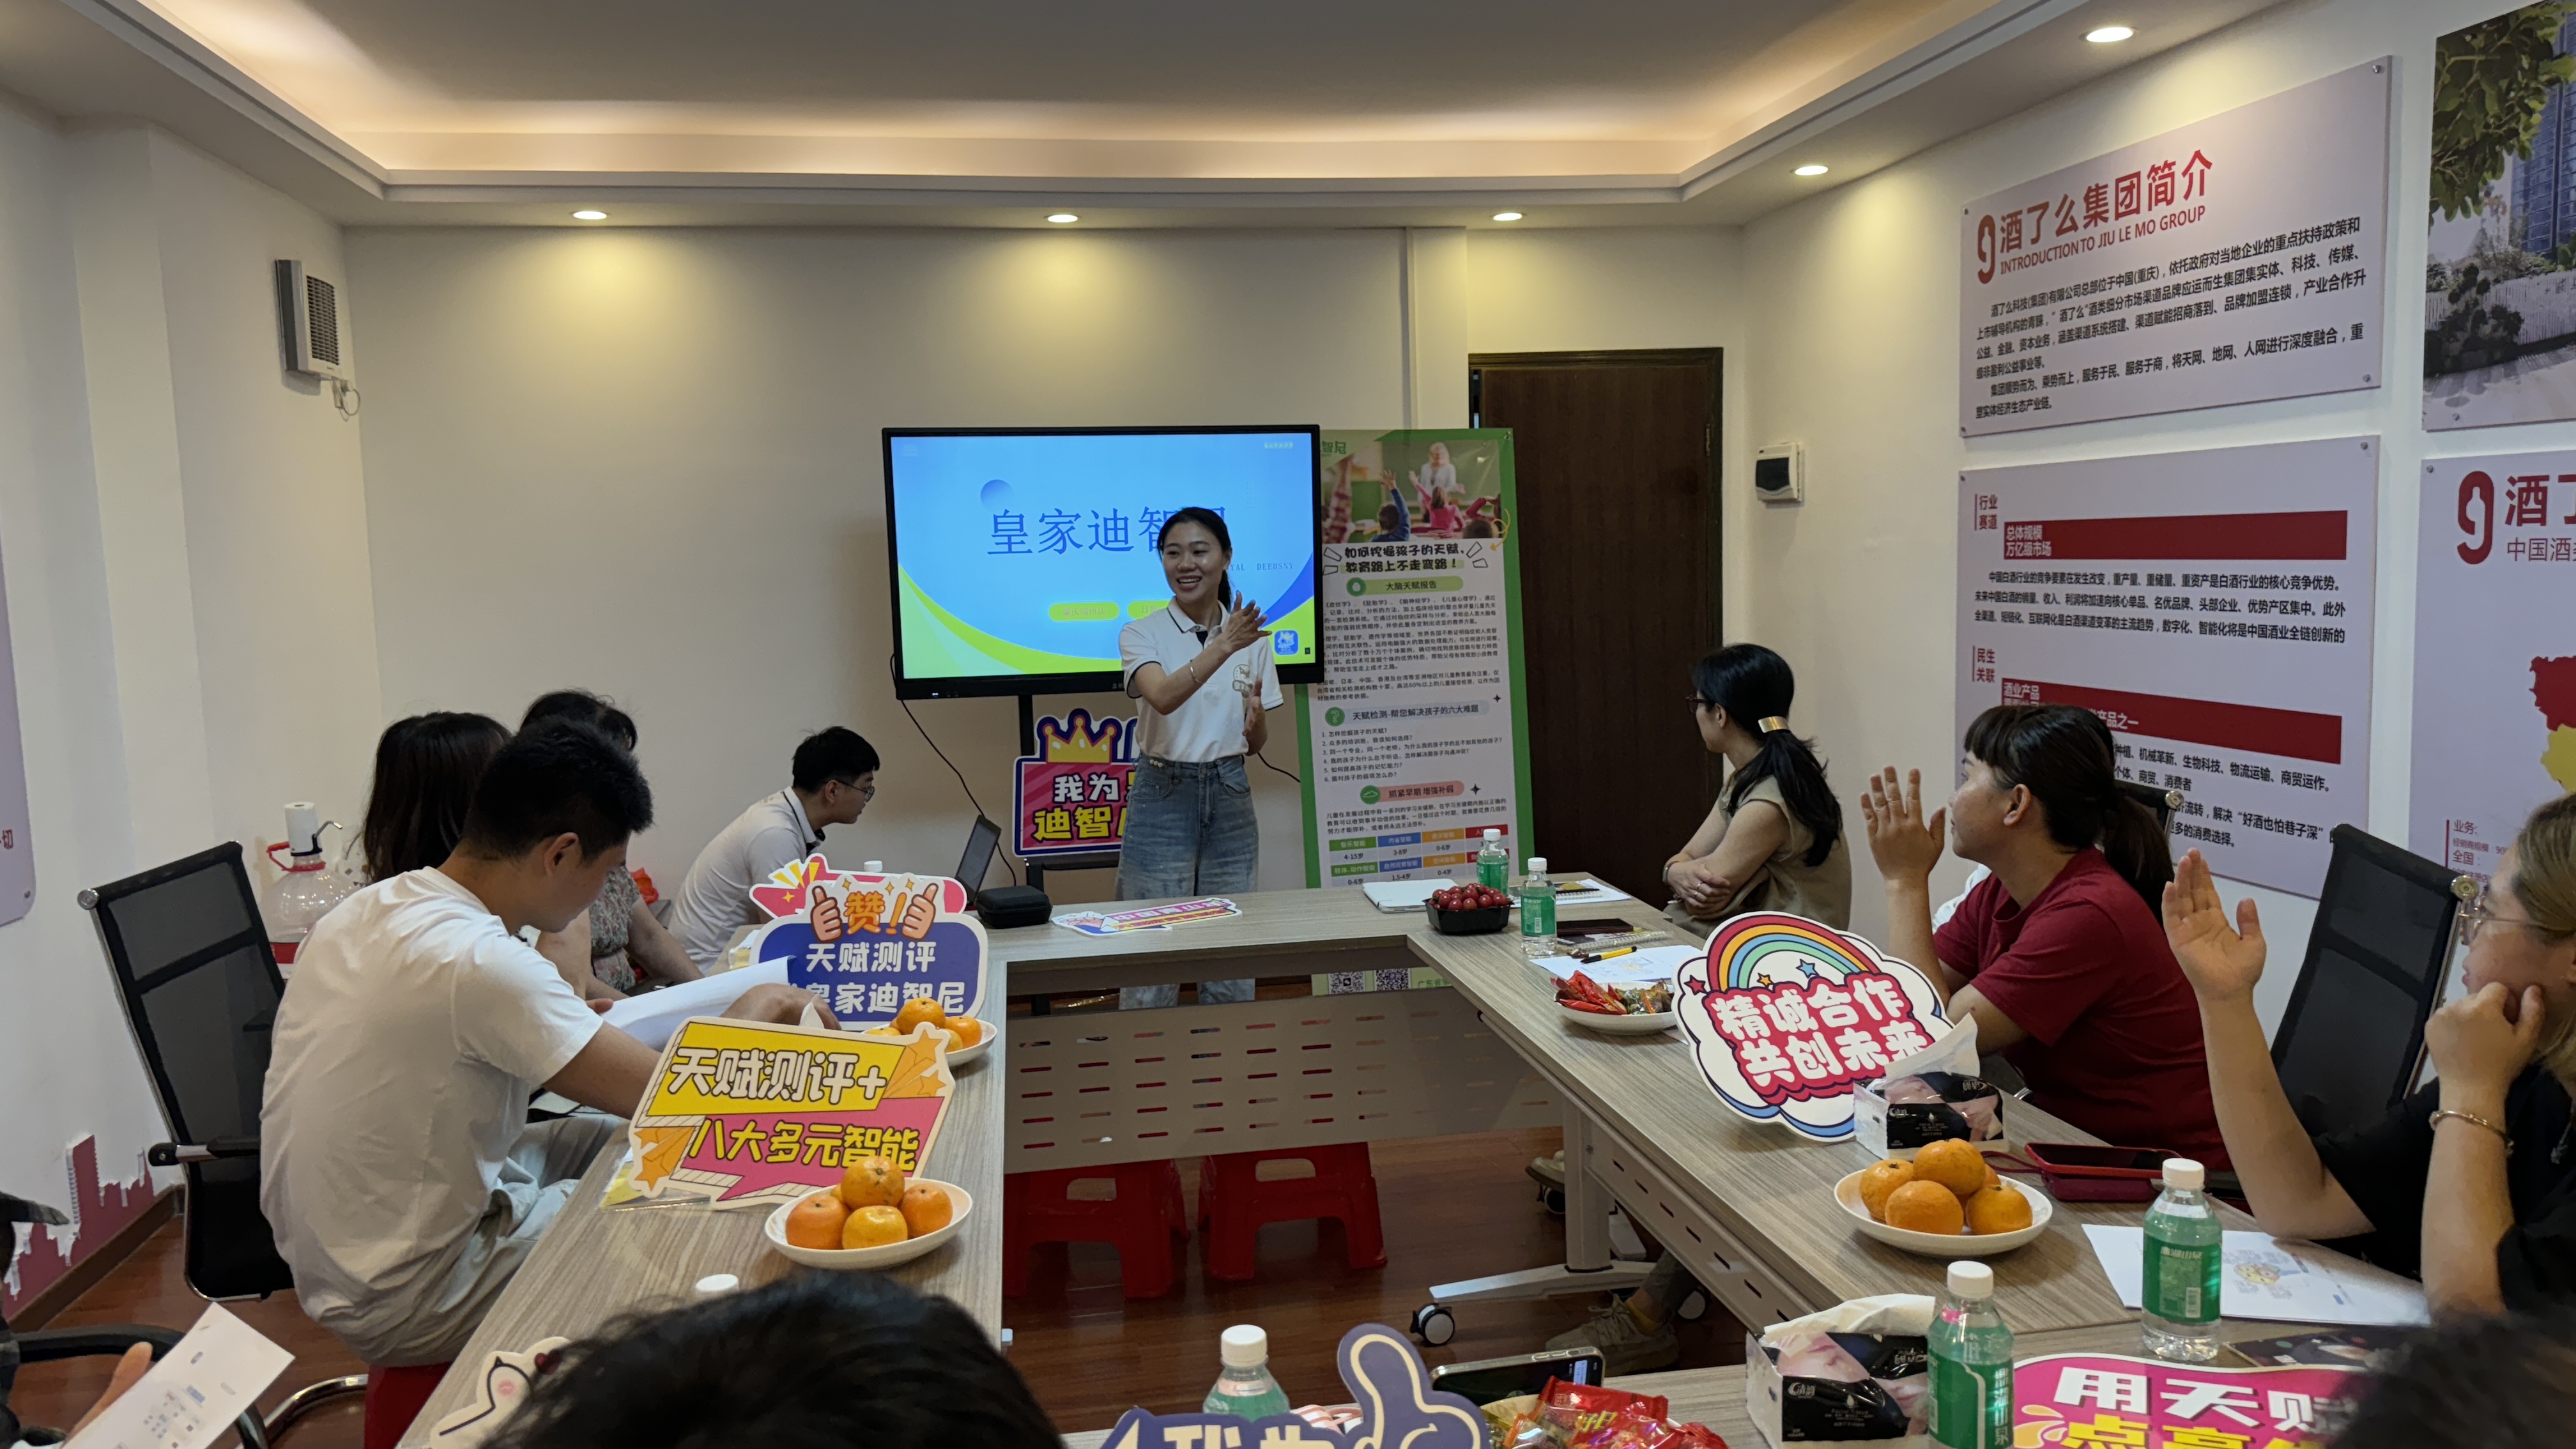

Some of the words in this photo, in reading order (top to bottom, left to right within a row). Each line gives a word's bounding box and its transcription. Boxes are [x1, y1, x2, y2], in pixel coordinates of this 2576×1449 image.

[2000, 149, 2212, 254] 酒了么集团简介
[2000, 239, 2079, 275] INTRODUCTION
[2080, 236, 2095, 254] TO
[2098, 229, 2115, 249] JIU
[2119, 225, 2131, 241] LE
[2135, 220, 2156, 238] MO
[2159, 204, 2206, 230] GROUP
[1979, 494, 1998, 511] 行业
[987, 506, 1225, 555] 皇家迪智
[2005, 524, 2044, 542] 总体规模
[2005, 540, 2053, 558] 万亿级市场
[1385, 579, 1438, 592] 大脑天赋报告
[1977, 648, 1996, 665] 民生
[1975, 665, 1996, 684] 关联
[2003, 681, 2040, 702] 酒业产品
[2087, 705, 2140, 732] 产品之一
[2171, 823, 2235, 848] 多的消费选择。
[2173, 799, 2334, 845] 流转，解决“好酒也怕巷子深”
[0, 829, 13, 850] 切
[806, 941, 937, 972] 天赋测评
[1712, 977, 1905, 1040] 精诚合作
[1740, 1020, 1928, 1087] 共创未来
[667, 1046, 888, 1105] 天赋测评+
[688, 1118, 920, 1172] 八大多元智能
